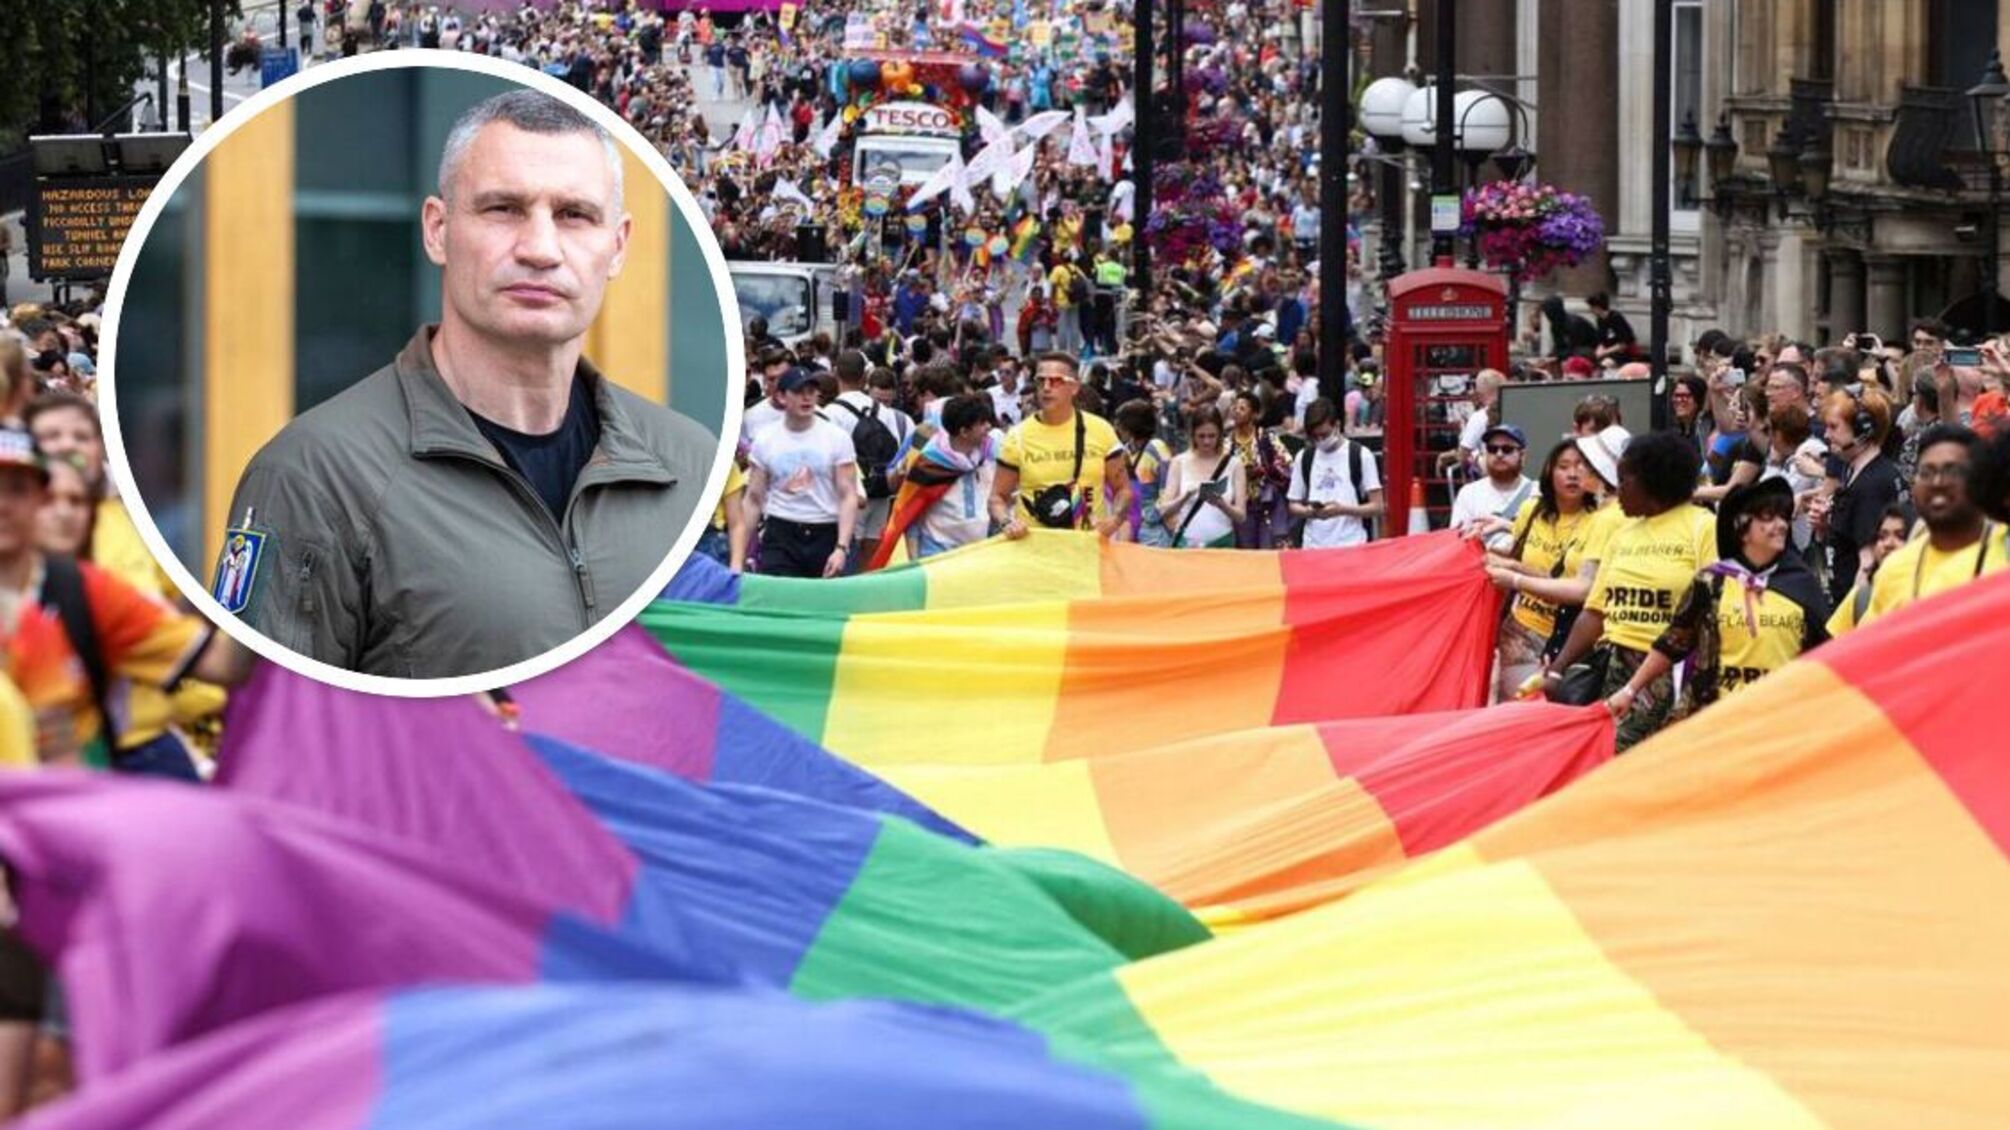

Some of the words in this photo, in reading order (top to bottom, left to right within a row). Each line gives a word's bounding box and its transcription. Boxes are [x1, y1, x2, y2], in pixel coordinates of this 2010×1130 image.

[873, 108, 950, 129] TESCO
[42, 188, 119, 200] HAZARDOUS
[69, 202, 111, 213] ACCESS
[43, 216, 105, 228] PICCADILLY
